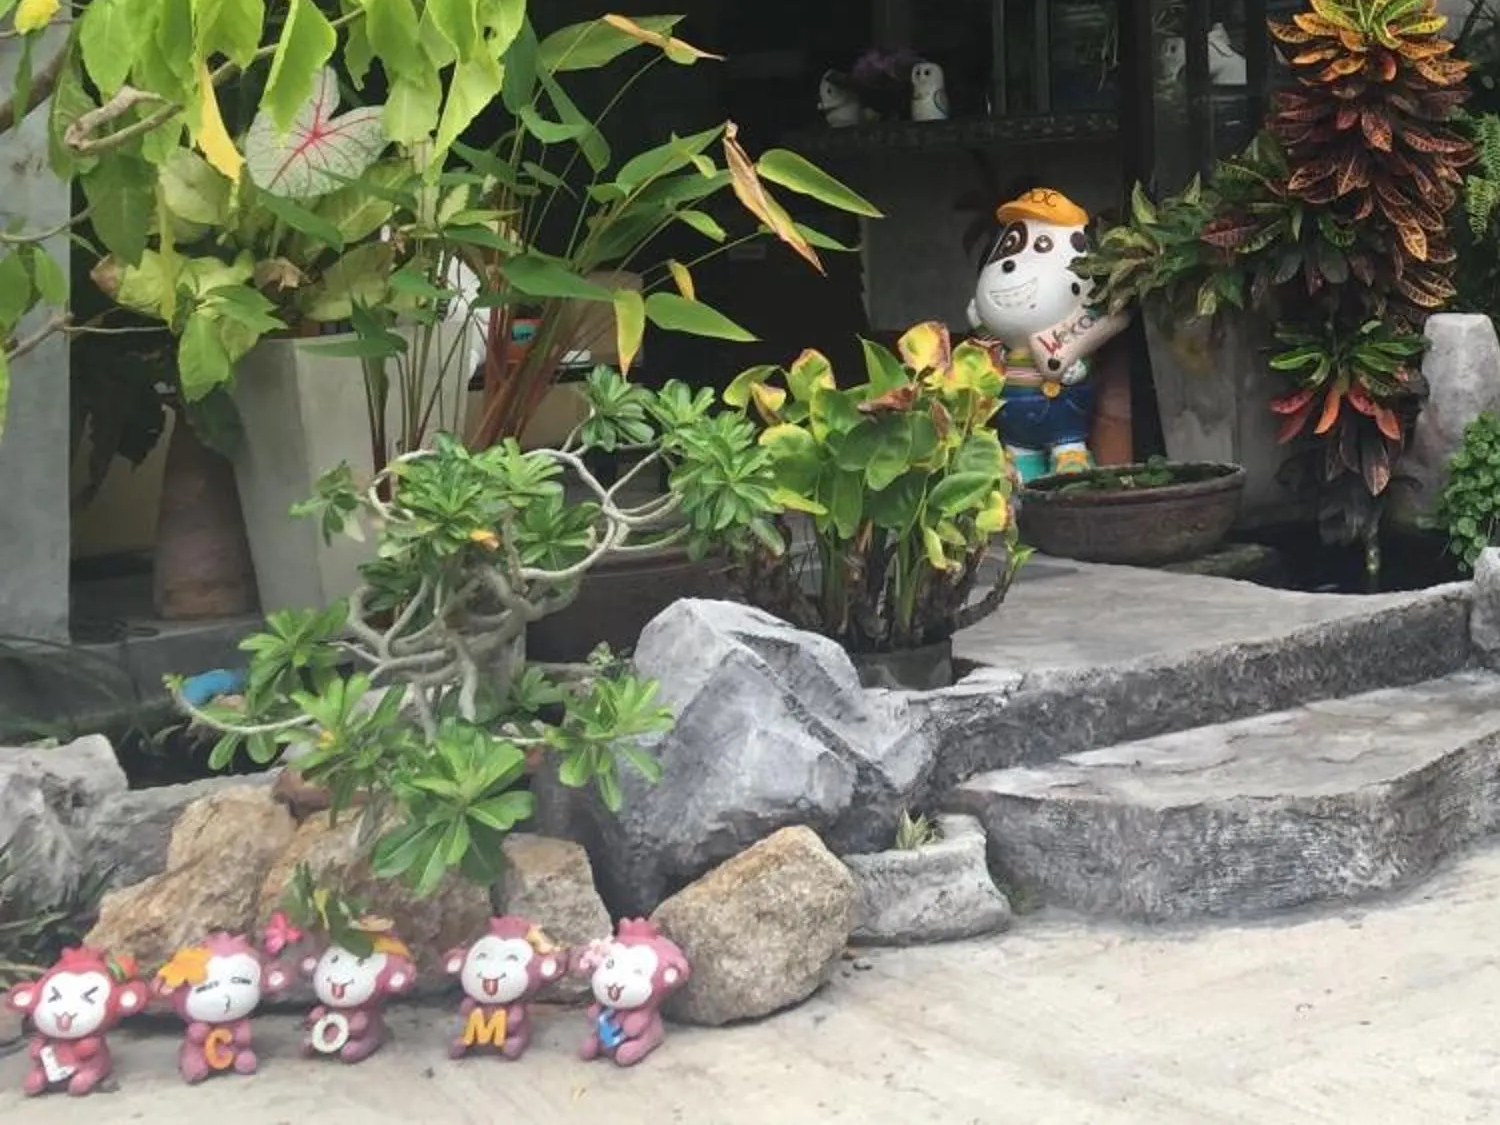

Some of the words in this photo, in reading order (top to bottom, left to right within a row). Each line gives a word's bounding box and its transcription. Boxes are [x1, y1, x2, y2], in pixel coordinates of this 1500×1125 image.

[204, 1027, 234, 1070] C
[312, 1012, 349, 1053] O
[463, 1007, 507, 1048] M
